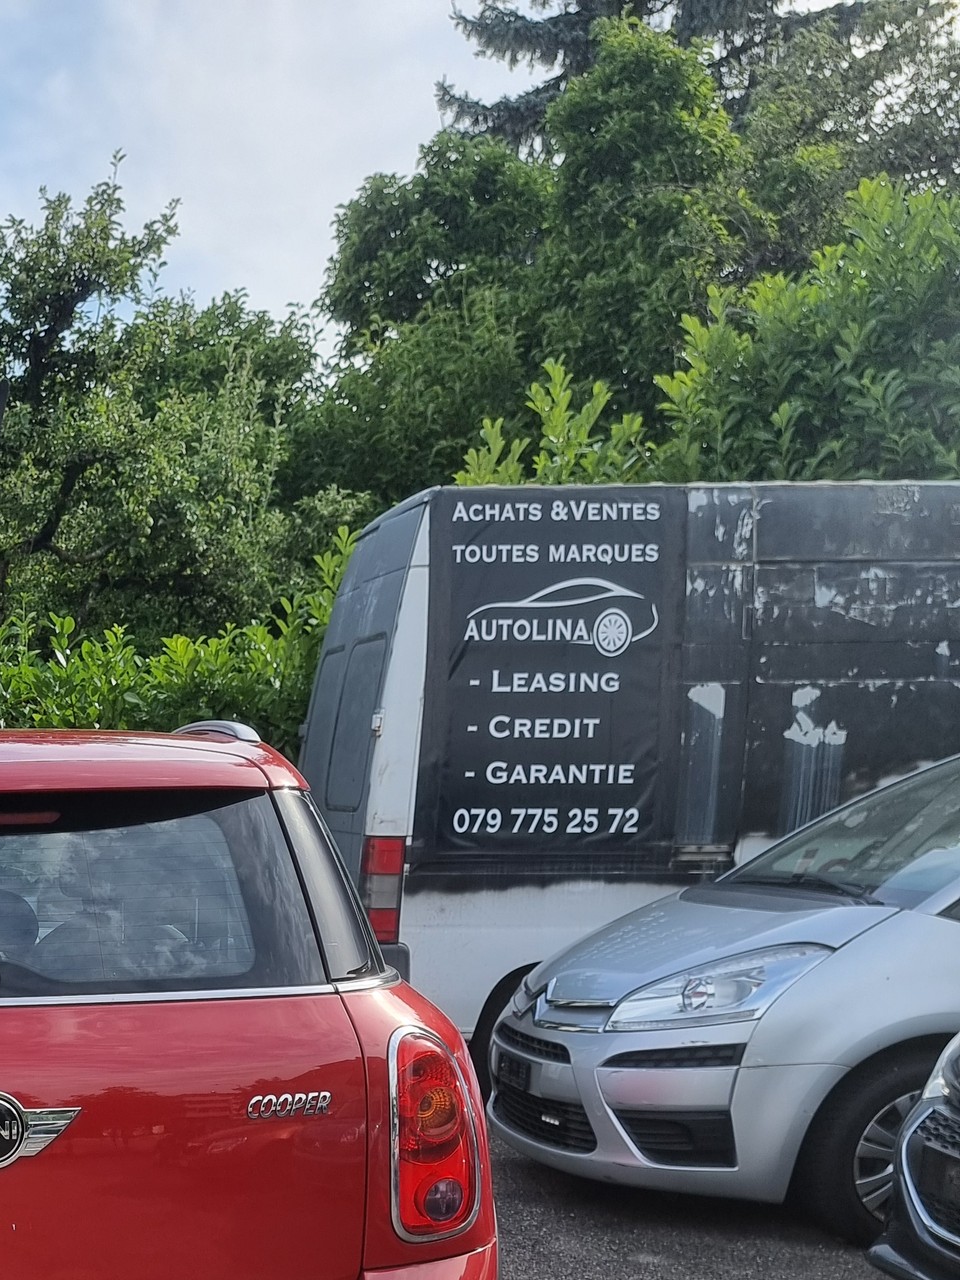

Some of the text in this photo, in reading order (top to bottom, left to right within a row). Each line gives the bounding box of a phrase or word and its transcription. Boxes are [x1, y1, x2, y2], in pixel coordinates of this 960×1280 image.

[452, 501, 542, 522] ACHATS
[452, 544, 660, 565] TOUTES MARQUES
[463, 618, 589, 642] AUTOLINA
[452, 808, 640, 834] 079 775 25 72
[247, 1090, 332, 1120] COOPER
